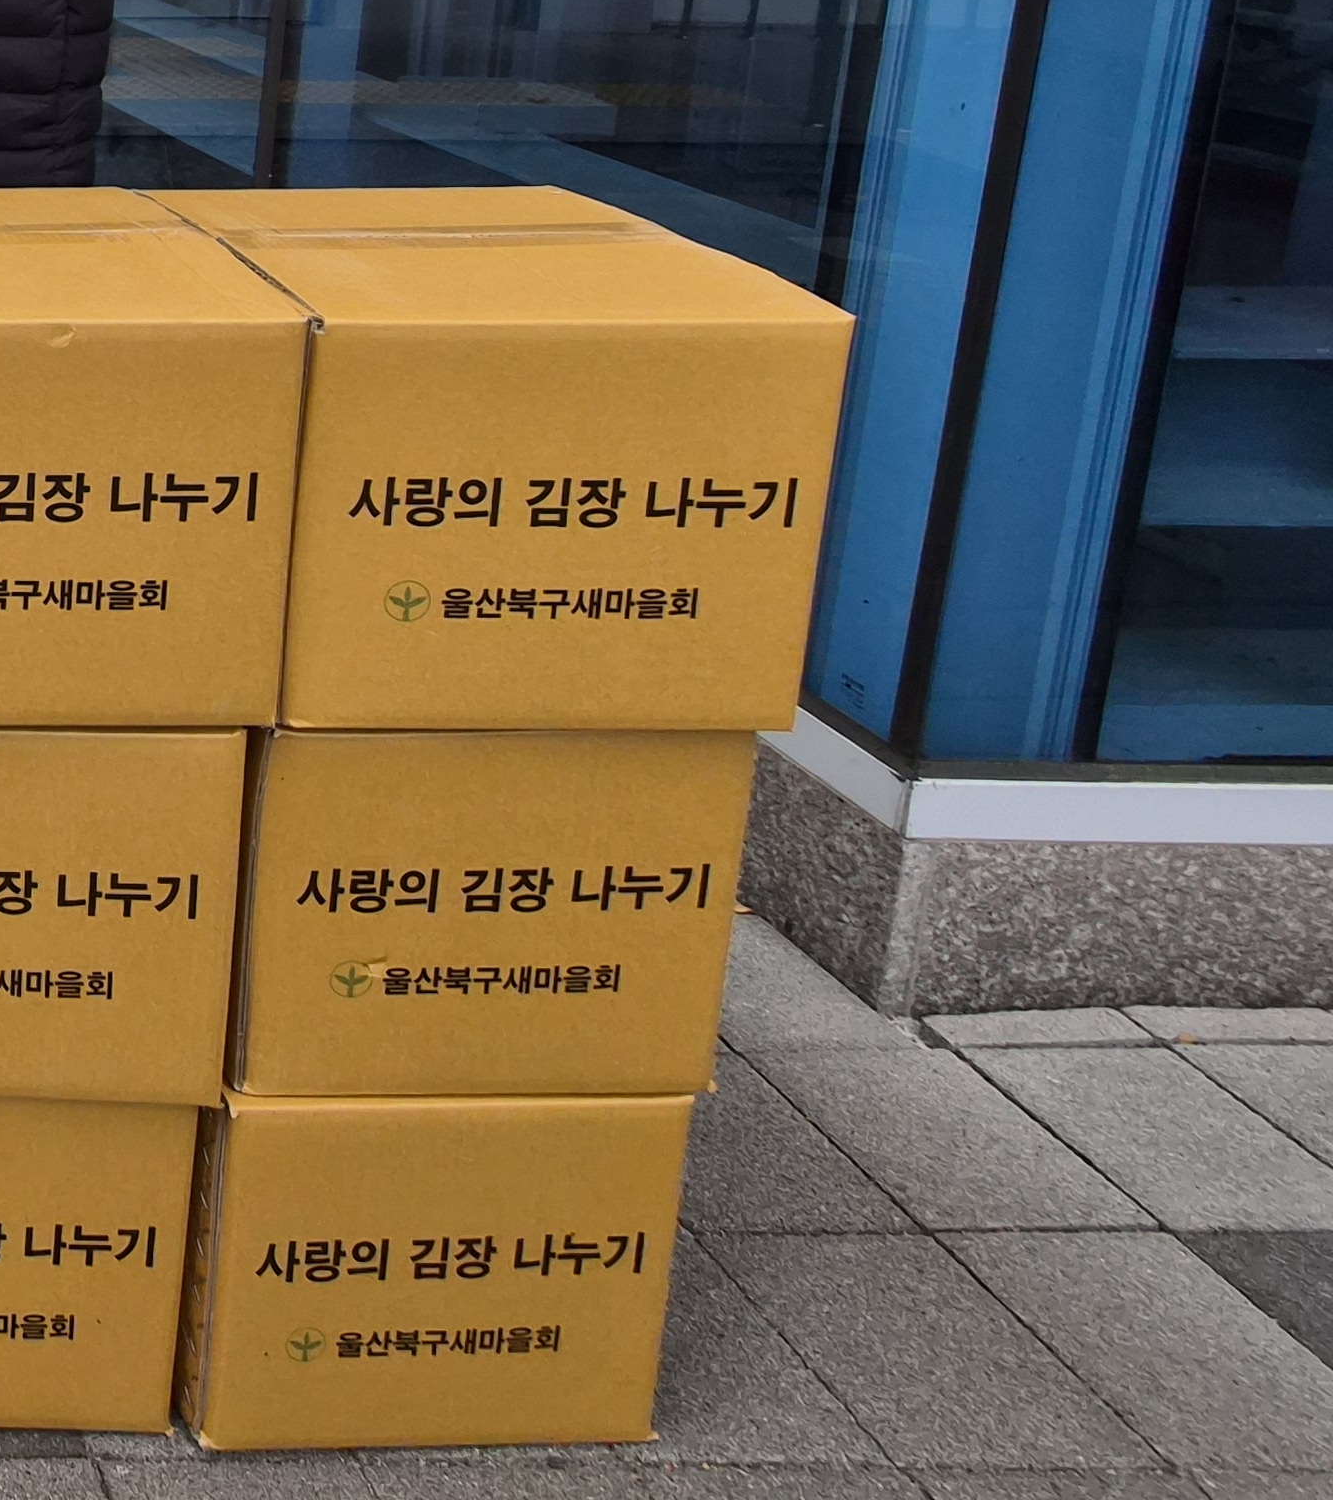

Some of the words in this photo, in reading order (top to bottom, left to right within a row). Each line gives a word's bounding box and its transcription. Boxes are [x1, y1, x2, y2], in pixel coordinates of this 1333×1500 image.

[110, 472, 259, 523] 나누기
[348, 476, 503, 528] 사랑의
[525, 477, 627, 529] 김장
[645, 477, 799, 528] 나누기
[441, 587, 699, 620] 울산북구새마을회
[57, 871, 199, 920] 나누기
[296, 868, 440, 914] 사랑의
[461, 866, 555, 913] 김장
[571, 863, 711, 912] 나누기
[382, 963, 621, 996] 울산북구새마을회
[24, 1223, 157, 1268] 나누기
[255, 1238, 390, 1284] 사랑의
[409, 1235, 498, 1280] 김장
[513, 1231, 645, 1277] 나누기
[335, 1325, 561, 1358] 울산북구새마을회
